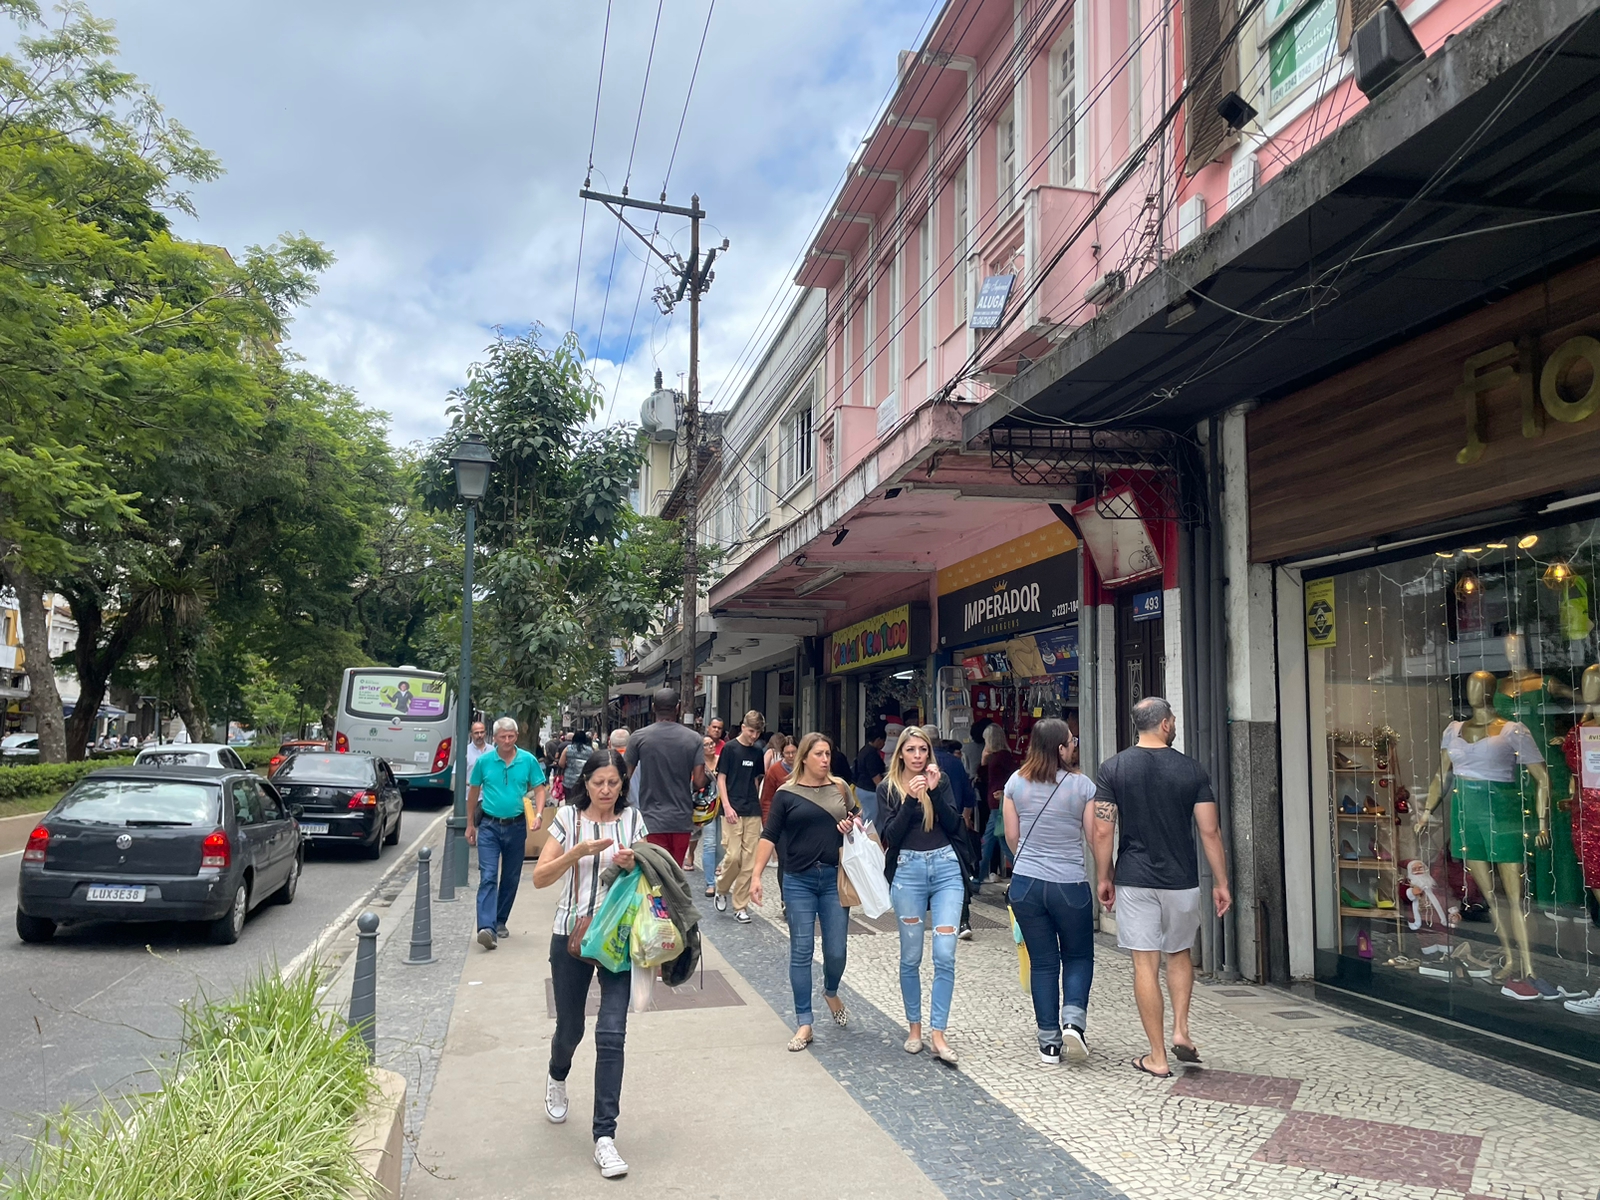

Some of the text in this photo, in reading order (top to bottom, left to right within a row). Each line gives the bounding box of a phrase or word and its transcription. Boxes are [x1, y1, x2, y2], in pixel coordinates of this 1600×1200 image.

[976, 295, 1005, 309] ALUGA
[964, 582, 1040, 632] IMPERADOR
[1144, 596, 1159, 611] 493
[983, 618, 1020, 634] FERRAGENS
[92, 889, 139, 900] LUX3E38
